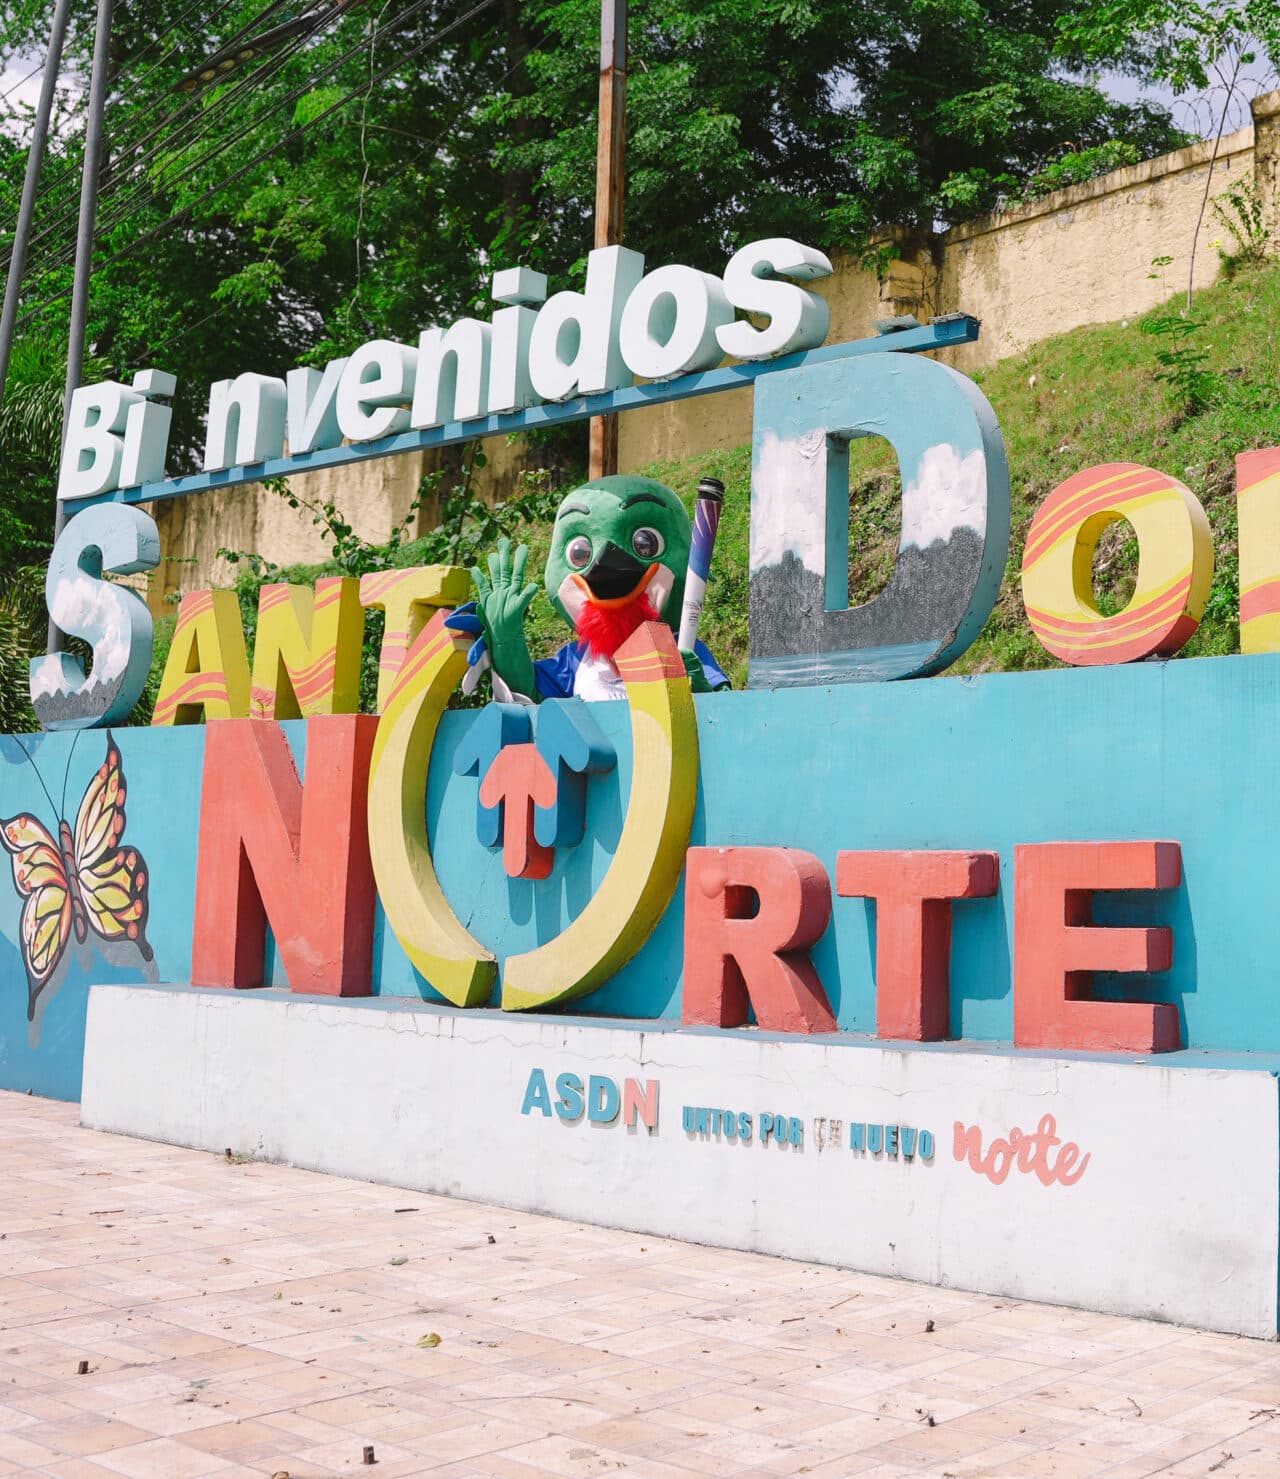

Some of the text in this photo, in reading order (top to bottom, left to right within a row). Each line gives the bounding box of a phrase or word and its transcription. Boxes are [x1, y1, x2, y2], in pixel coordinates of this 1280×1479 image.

[521, 1068, 659, 1134] ASDN
[759, 1112, 803, 1147] POR
[850, 1121, 935, 1161] NUEVO
[952, 1113, 1090, 1186] norte
